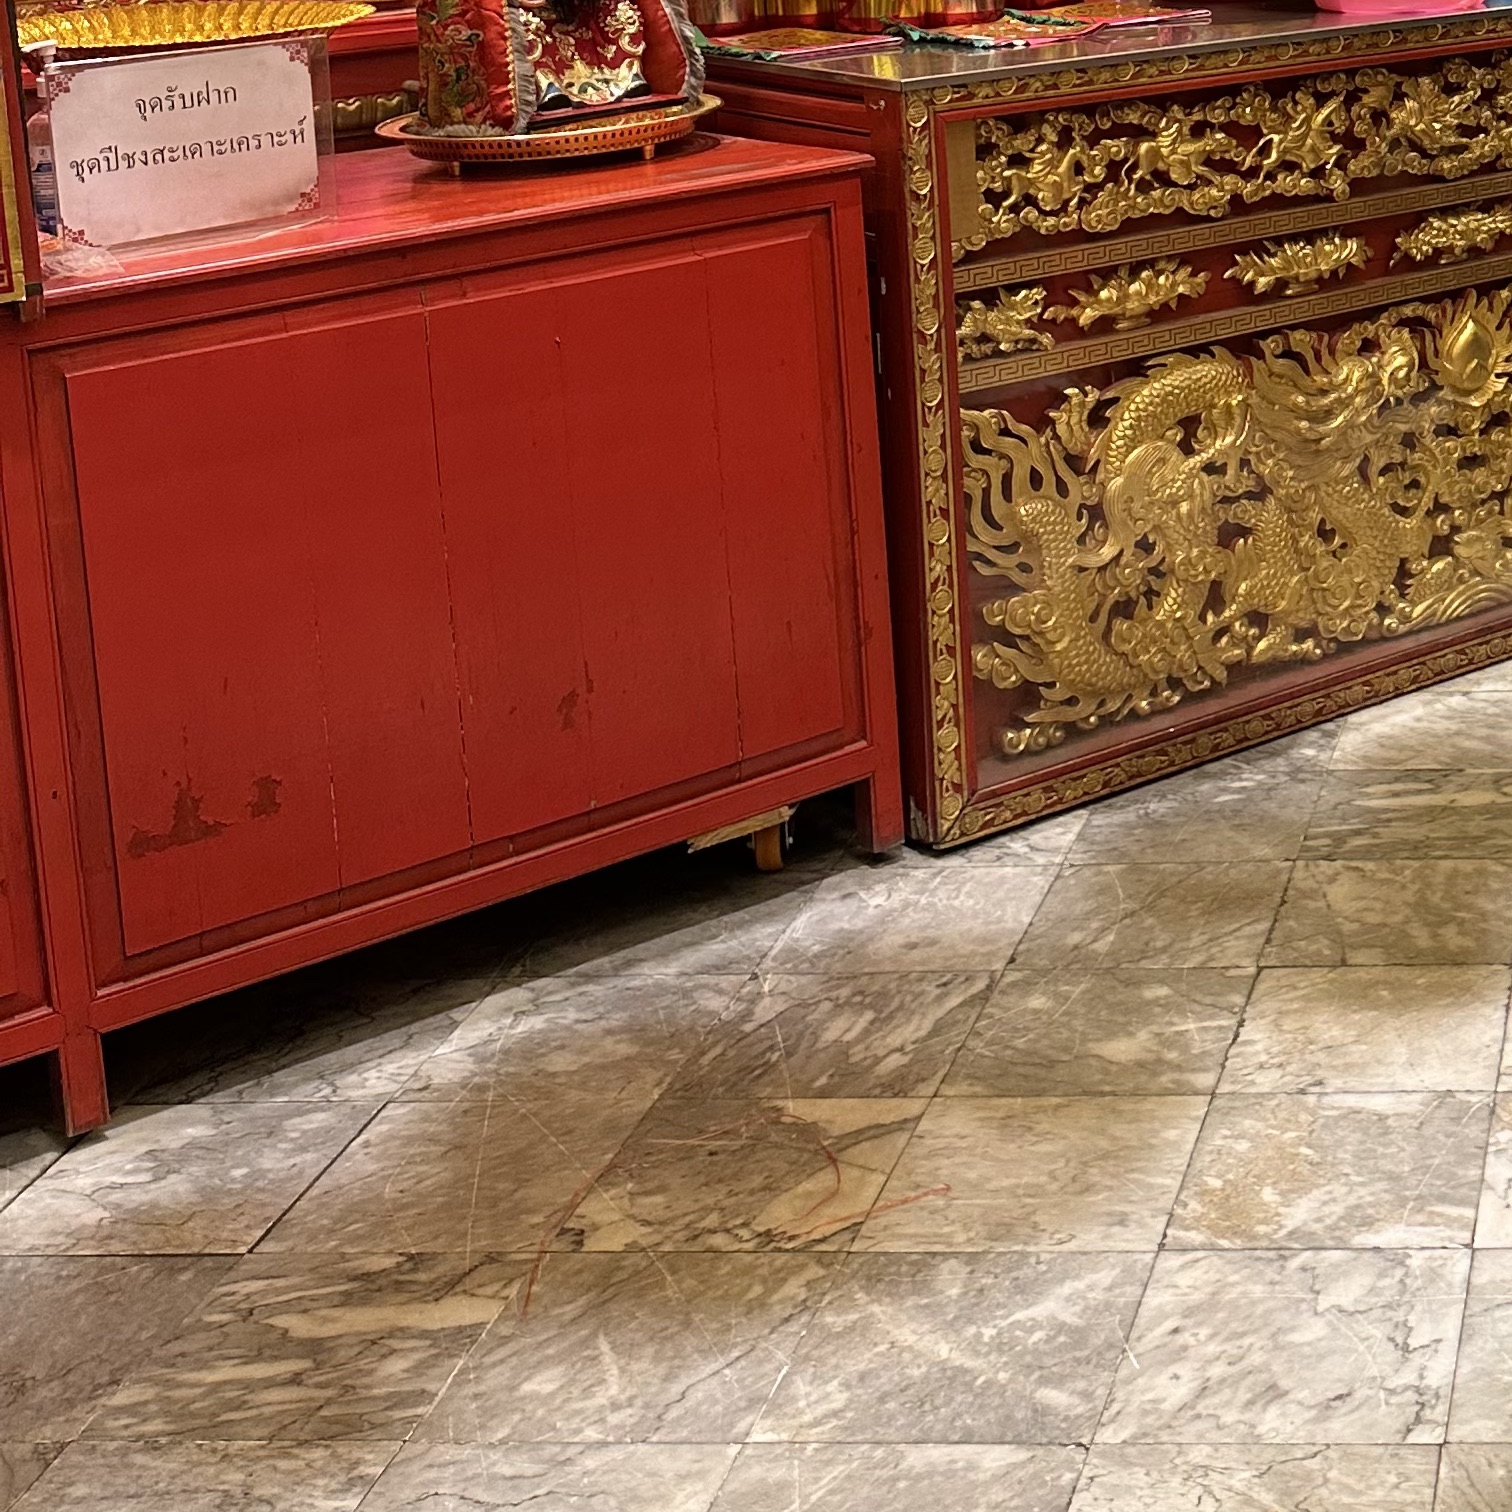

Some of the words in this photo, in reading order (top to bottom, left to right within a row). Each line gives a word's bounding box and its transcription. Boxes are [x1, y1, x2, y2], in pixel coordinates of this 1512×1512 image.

[134, 80, 238, 122] จุดรับฝาก
[69, 115, 308, 184] ชุดปีชงสะเดาะเคราะห์
